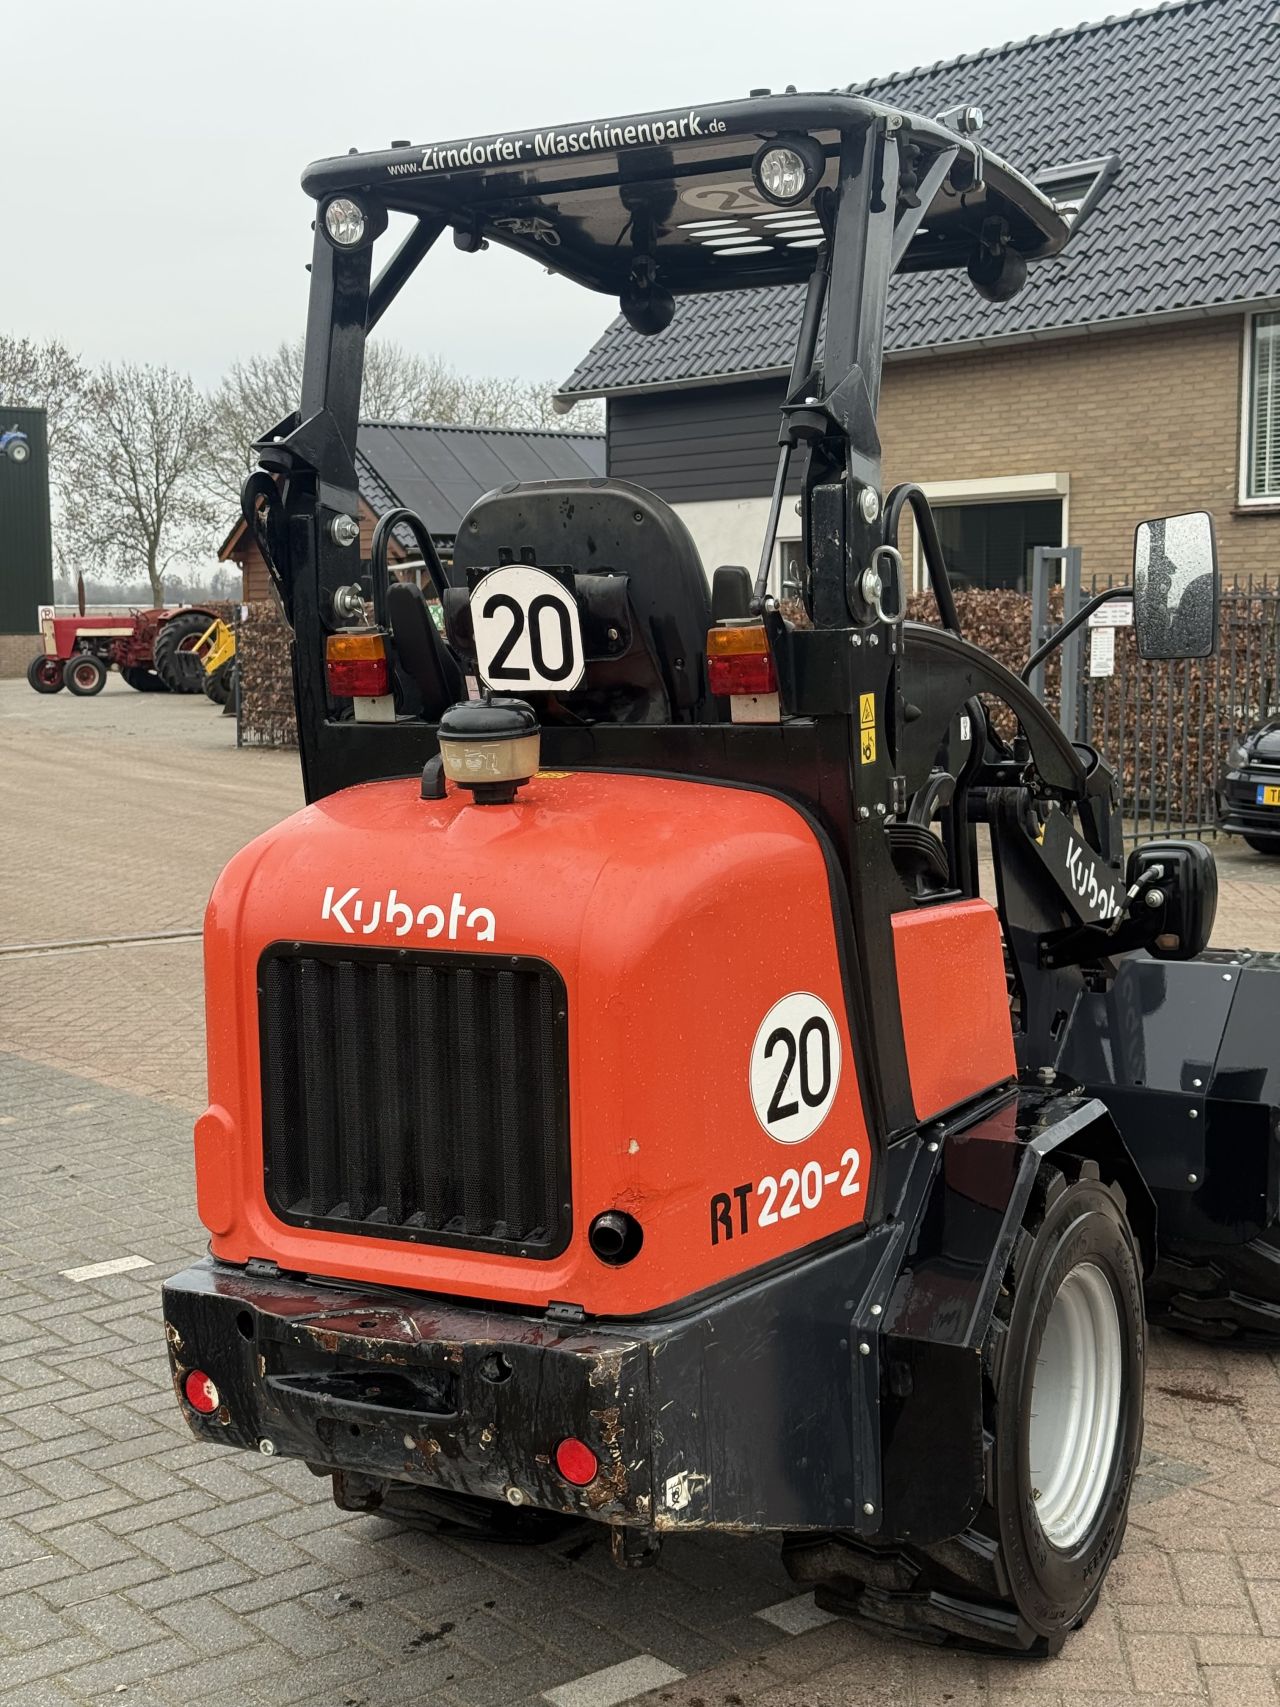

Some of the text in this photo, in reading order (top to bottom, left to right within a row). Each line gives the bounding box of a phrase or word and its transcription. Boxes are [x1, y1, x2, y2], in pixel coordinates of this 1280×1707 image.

[387, 111, 727, 176] www.Zirndorfer-Maschinenpark.de
[482, 593, 575, 682] 20
[321, 886, 496, 942] Kubota
[764, 1016, 831, 1124] 20
